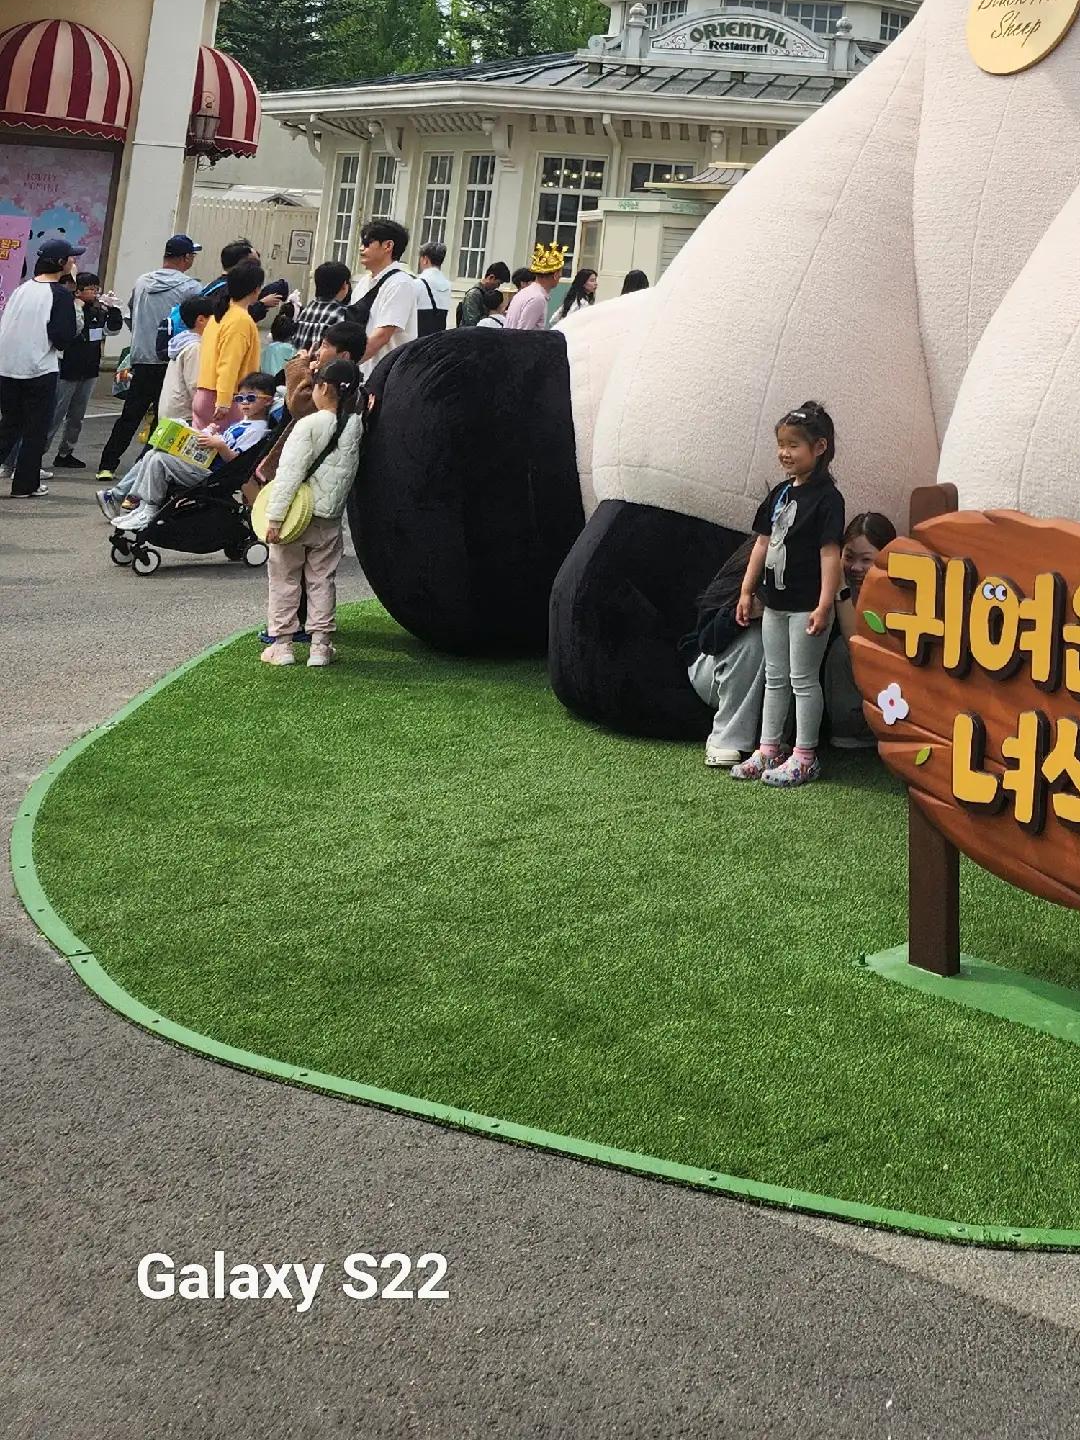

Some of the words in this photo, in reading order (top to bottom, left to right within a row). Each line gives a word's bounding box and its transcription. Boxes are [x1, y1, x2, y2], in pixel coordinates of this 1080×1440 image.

[689, 22, 788, 48] ORIENTAL
[990, 10, 1042, 48] Sheep
[708, 40, 768, 53] Restaurant
